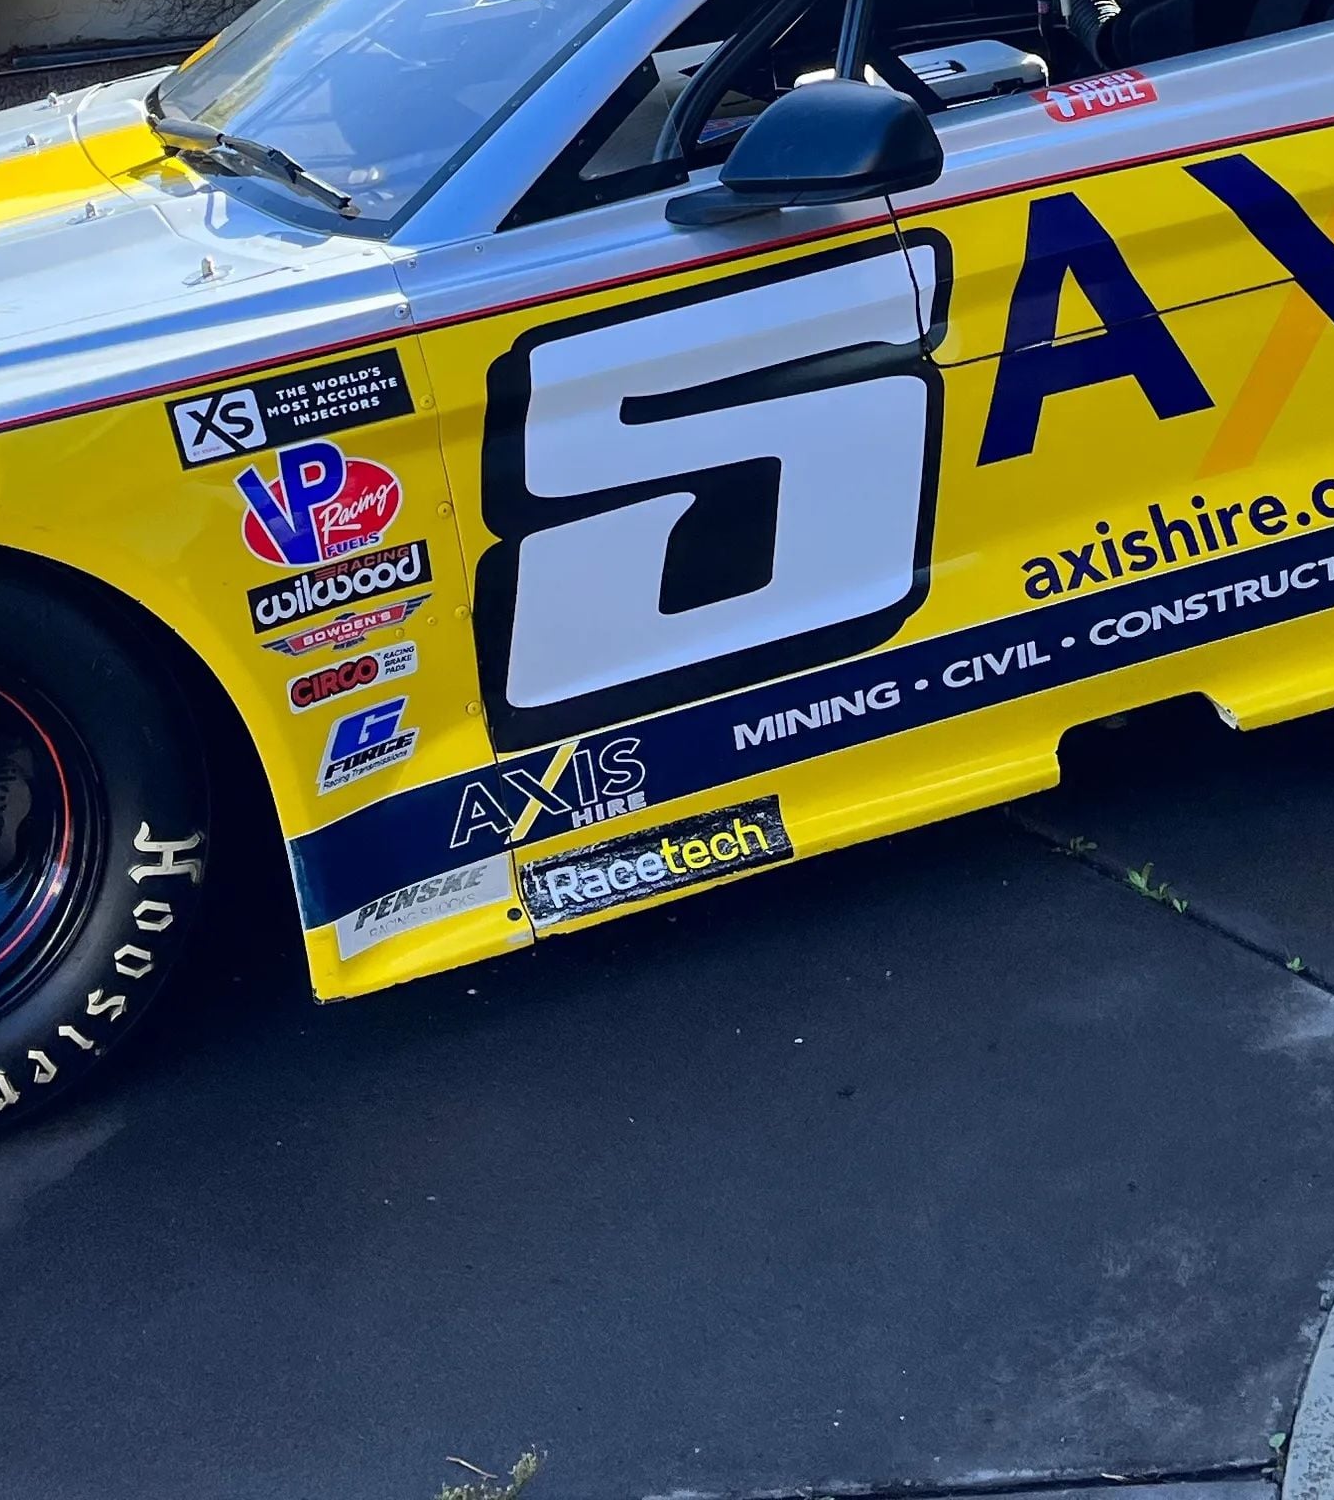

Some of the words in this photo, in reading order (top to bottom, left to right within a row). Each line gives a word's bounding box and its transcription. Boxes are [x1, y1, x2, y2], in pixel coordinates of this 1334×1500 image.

[1068, 72, 1135, 93] OPEN
[1079, 82, 1146, 111] PULL
[267, 400, 310, 418] MOST
[316, 377, 398, 406] ACCURATE
[276, 384, 307, 401] THE
[313, 366, 381, 392] WORLD'S
[186, 397, 255, 452] XS
[293, 396, 380, 426] INJECTORS
[234, 439, 347, 567] VP
[319, 481, 398, 544] Racing
[325, 531, 380, 558] FUELS
[336, 545, 410, 576] RACING
[255, 543, 422, 626] wilwood
[302, 611, 392, 647] BOWDEN'S
[383, 645, 416, 661] RACING
[384, 654, 412, 668] BRAKE
[384, 663, 406, 676] PADS
[291, 655, 379, 708] CIRCO
[732, 680, 901, 751] MINING
[942, 640, 1051, 691] CIVIL
[324, 731, 416, 781] FORCE
[449, 736, 647, 849] AXIS
[571, 793, 647, 829] HIRE
[545, 817, 770, 910] Racetech
[353, 864, 486, 932] PENSKE
[369, 910, 411, 940] RACING
